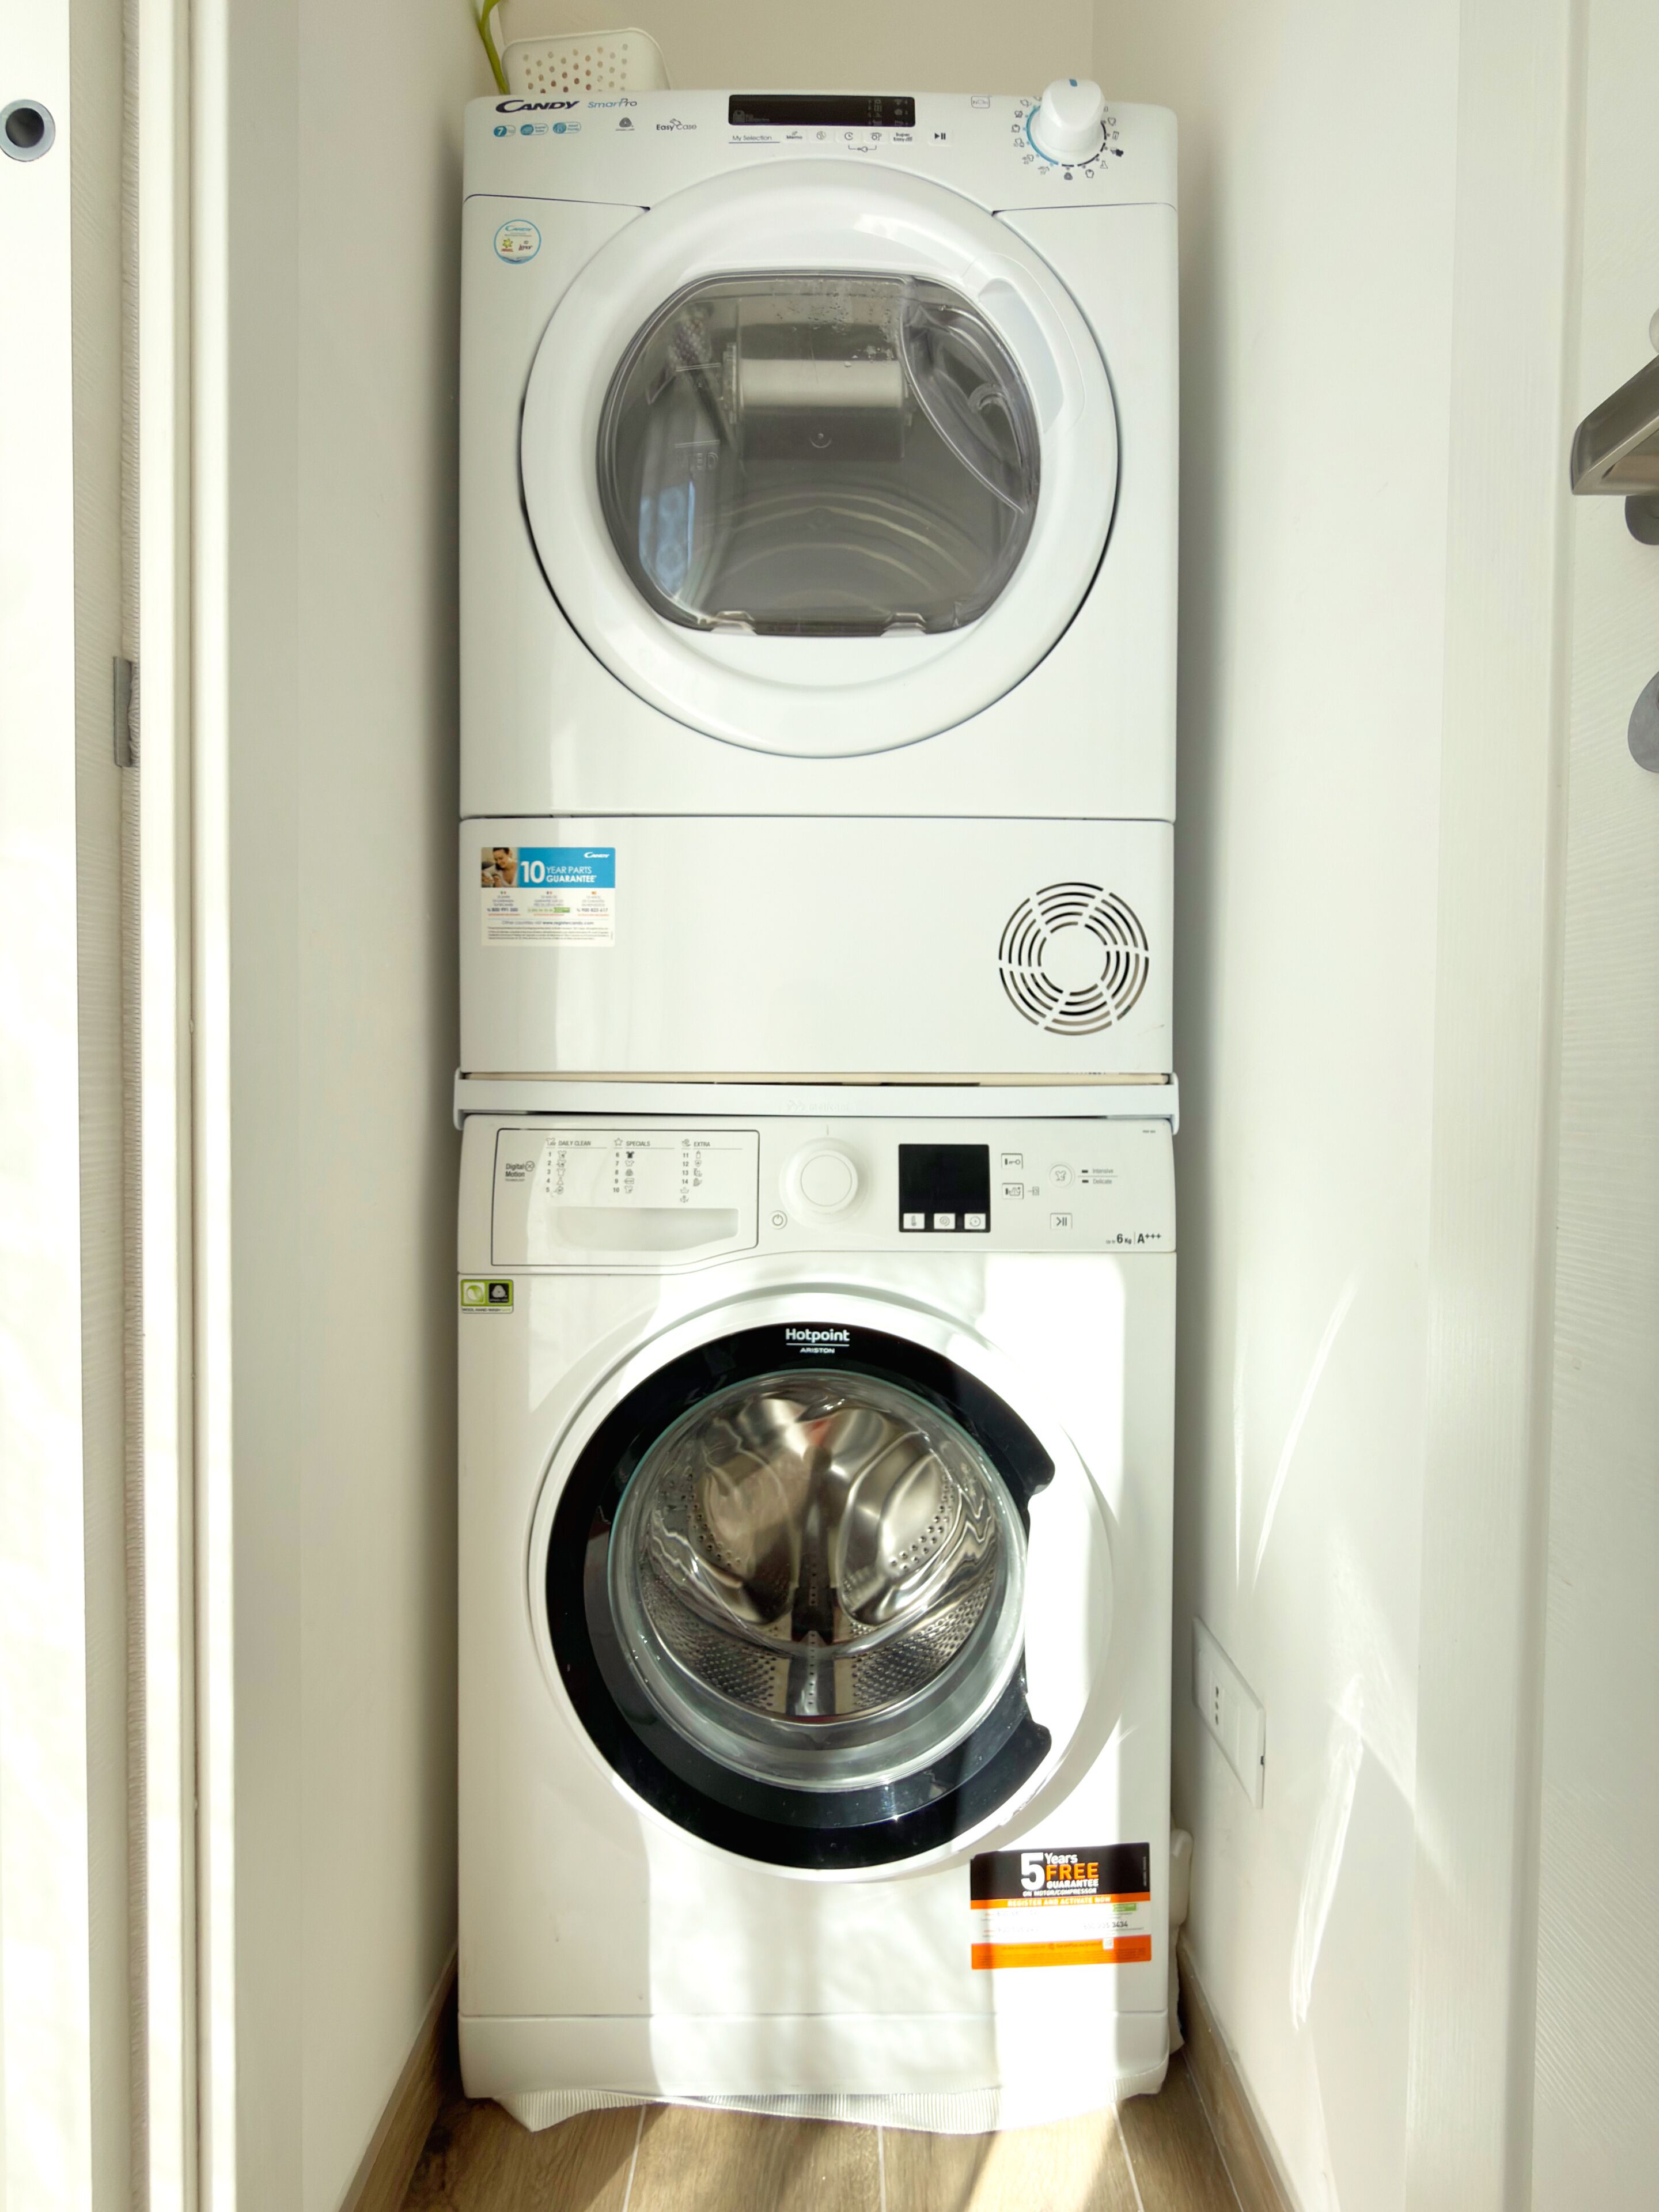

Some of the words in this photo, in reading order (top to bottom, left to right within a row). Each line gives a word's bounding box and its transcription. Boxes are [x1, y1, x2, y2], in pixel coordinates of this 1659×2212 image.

[495, 100, 580, 113] CANDY
[521, 860, 546, 883] 10
[506, 1163, 524, 1171] Digital
[1116, 1233, 1123, 1244] 6
[1137, 1233, 1161, 1243] A+++
[785, 1328, 850, 1343] Hotpoint
[1044, 1853, 1078, 1864] Years
[1021, 1852, 1045, 1891] 5
[1046, 1862, 1099, 1880] FREE
[1047, 1878, 1099, 1889] GUARANTEE
